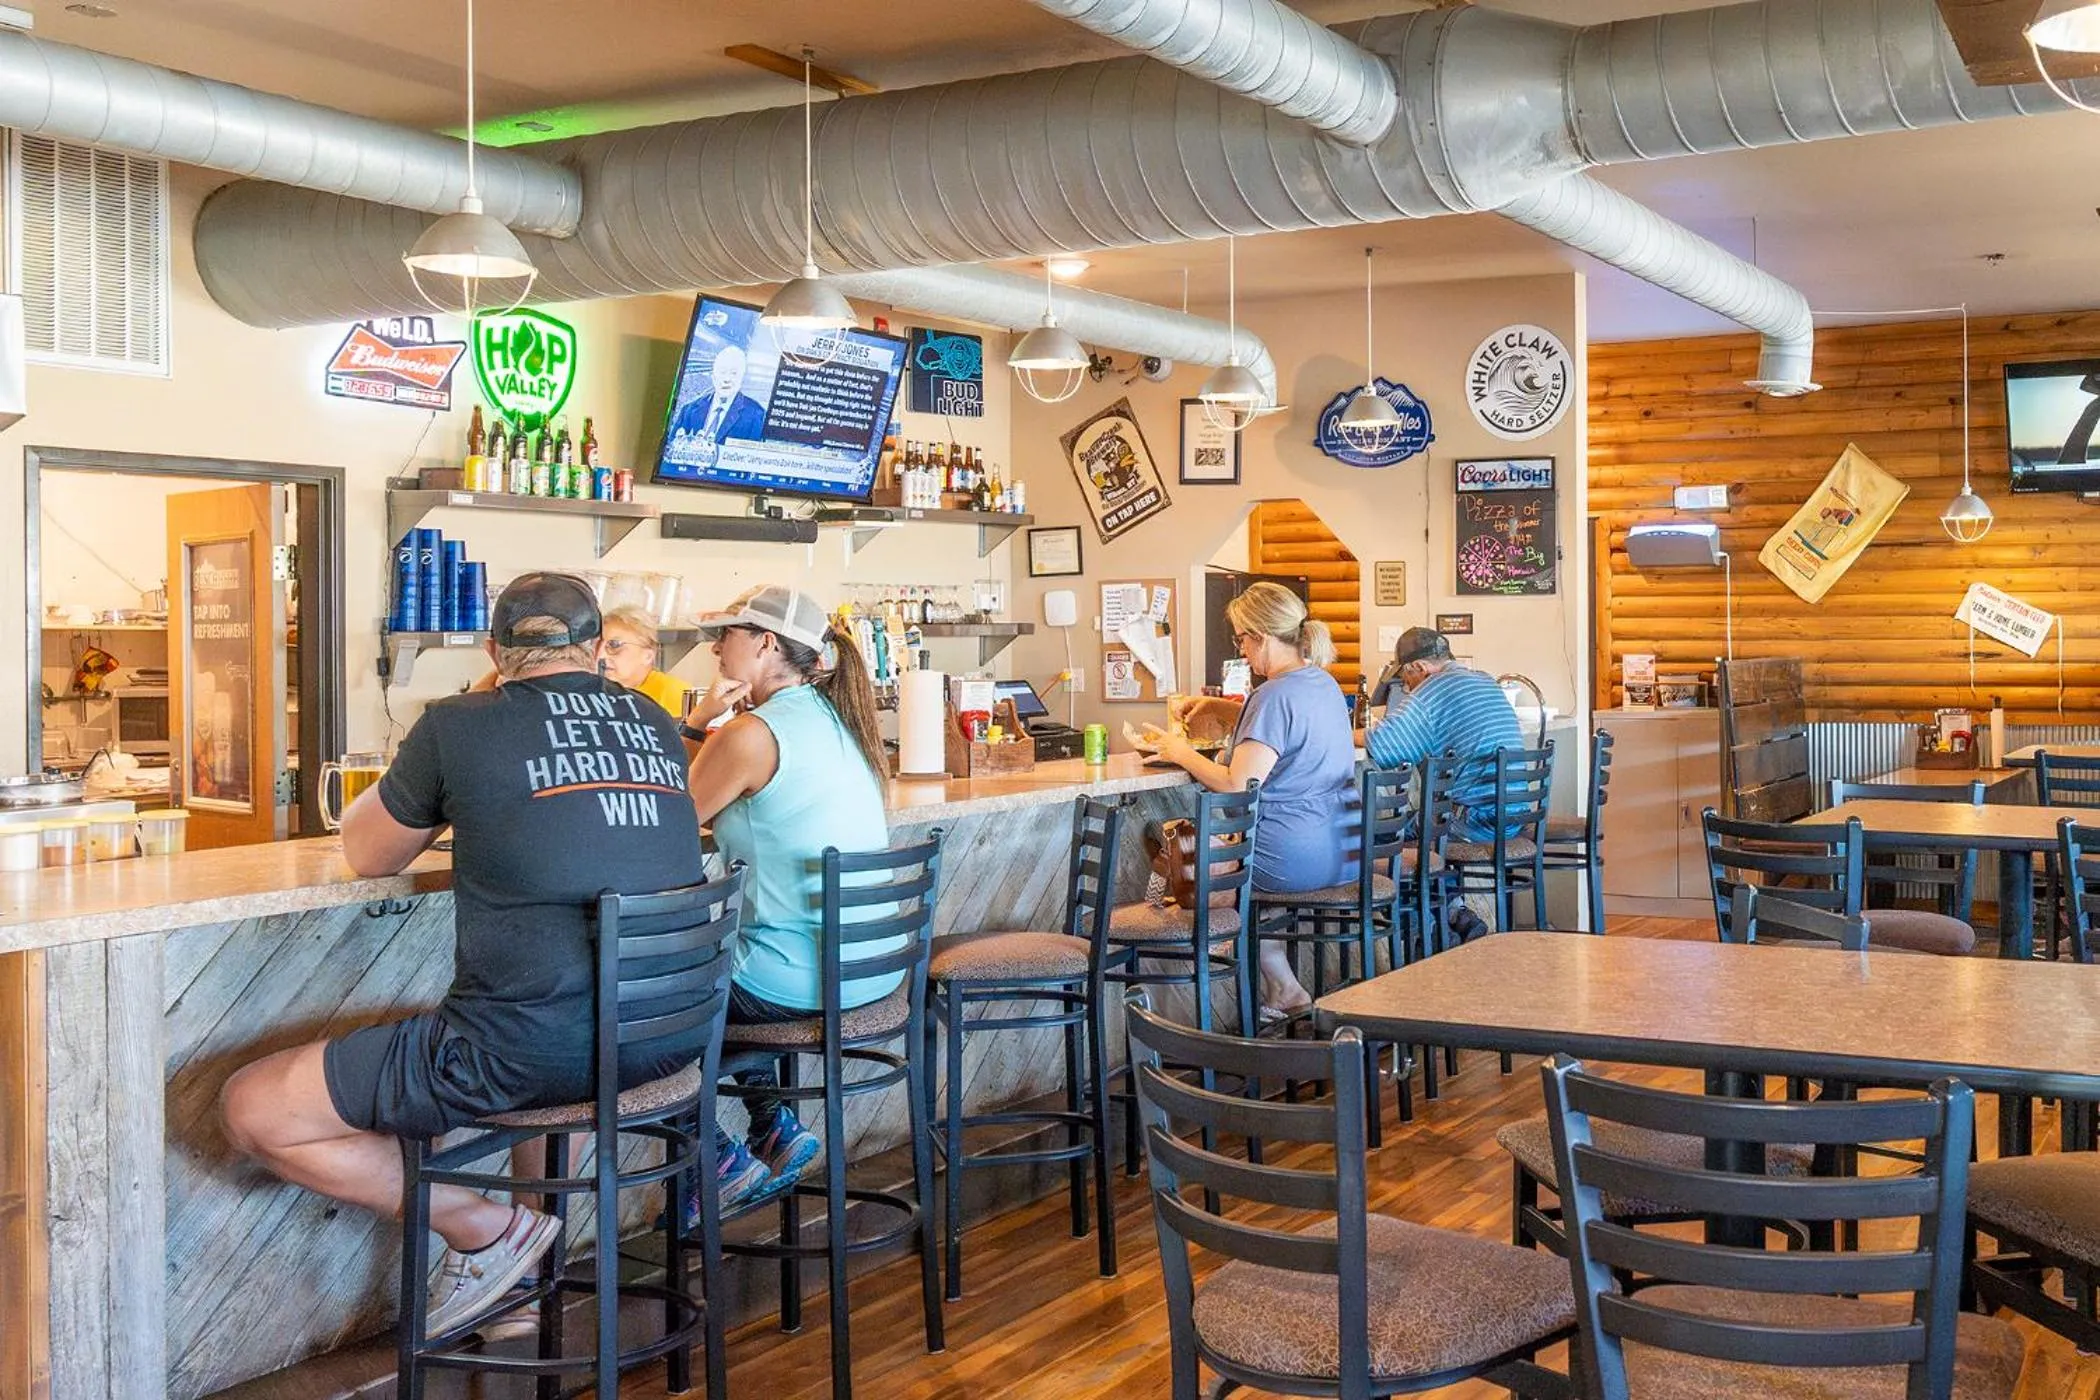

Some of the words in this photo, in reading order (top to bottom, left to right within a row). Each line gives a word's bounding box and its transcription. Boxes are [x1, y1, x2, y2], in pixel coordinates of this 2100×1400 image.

[347, 343, 447, 376] Budweiser
[1472, 341, 1502, 403] WHITE
[1504, 332, 1558, 360] CLAW
[494, 374, 557, 400] VALLEY
[943, 380, 978, 402] BUD
[1491, 409, 1524, 428] HARD
[1529, 372, 1561, 423] SELTZER
[937, 396, 984, 417] LIGHT
[1459, 464, 1508, 484] Coors
[1508, 469, 1551, 482] LIGHT
[1105, 515, 1119, 529] ON
[1117, 504, 1136, 521] TAP
[1134, 491, 1157, 511] HERE
[1459, 494, 1516, 521] Pizza
[1523, 499, 1542, 516] of
[1525, 546, 1545, 566] Big
[193, 605, 208, 620] TAP
[209, 604, 231, 619] INTO
[193, 622, 249, 639] REFRESHMENT
[544, 692, 641, 719] DON'T
[545, 719, 603, 749] LET
[607, 721, 663, 754] THE
[526, 751, 619, 791] HARD
[625, 752, 685, 791] DAYS
[597, 793, 659, 827] WIN
